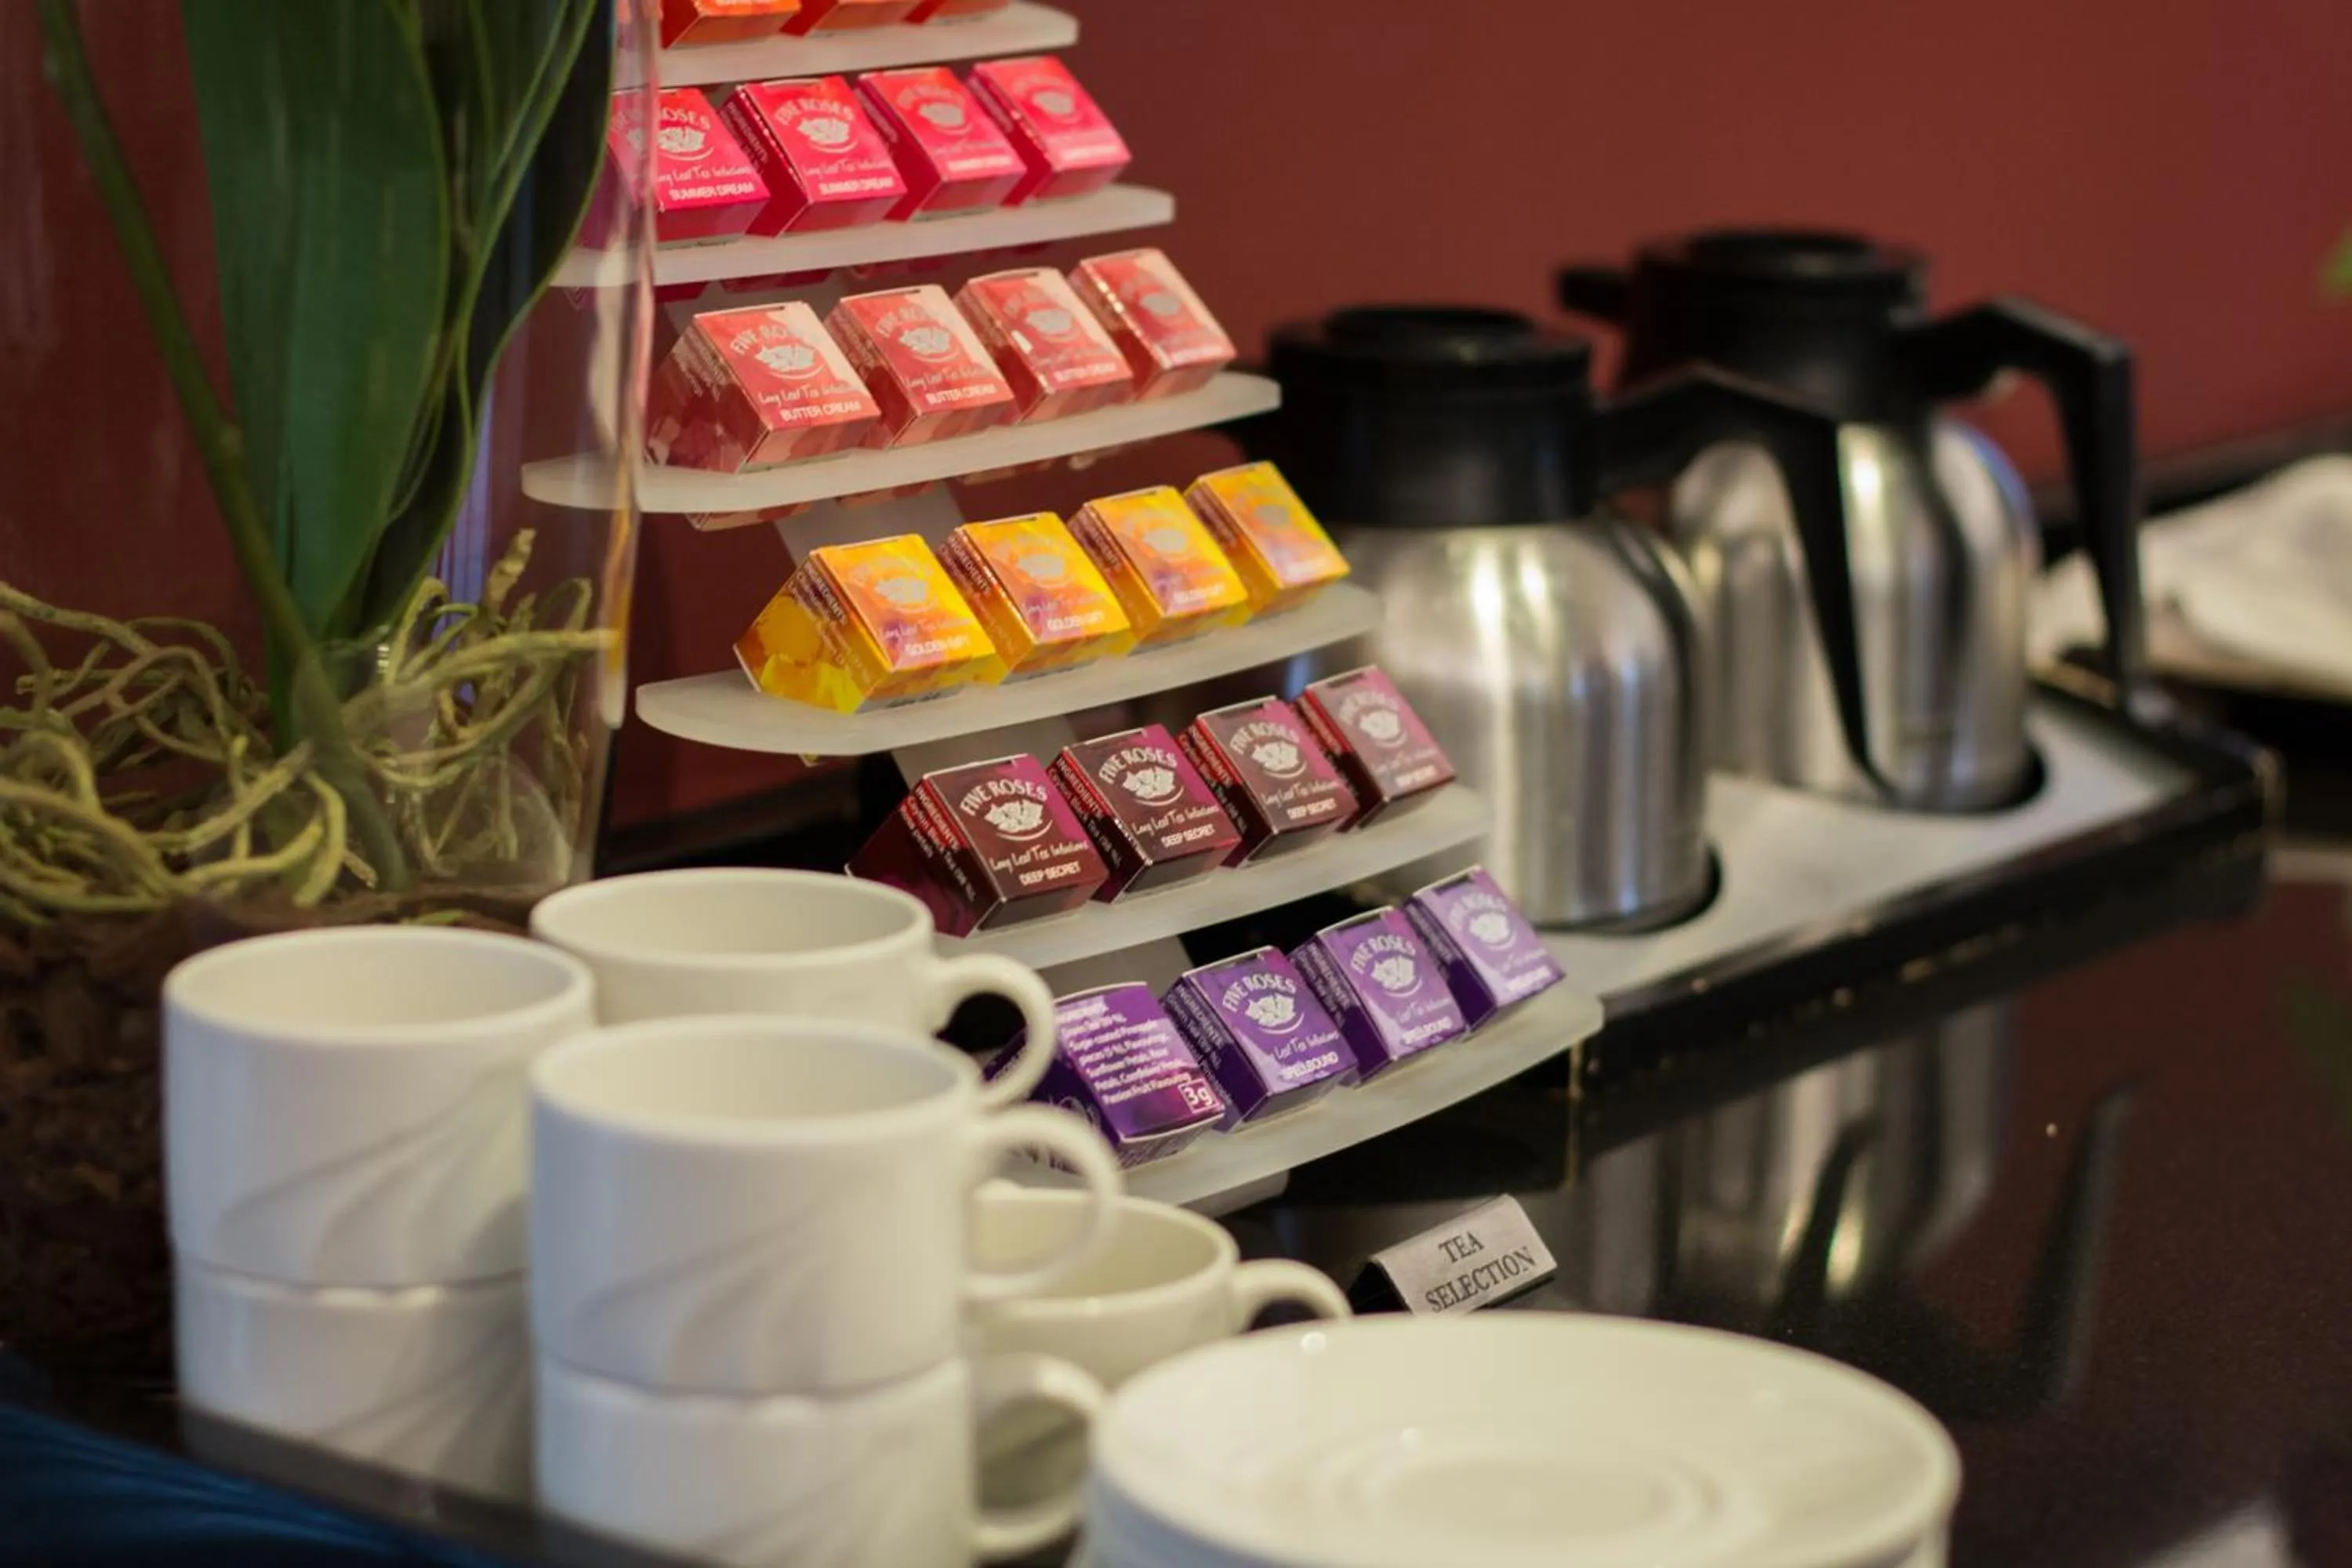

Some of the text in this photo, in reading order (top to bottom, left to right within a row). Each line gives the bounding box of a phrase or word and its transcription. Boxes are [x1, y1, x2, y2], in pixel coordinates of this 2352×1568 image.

[780, 400, 862, 422] BUTTER CREAM
[1229, 726, 1254, 755] FIVE
[1248, 722, 1301, 744] ROSES
[1098, 746, 1178, 784] FIVE ROSES
[959, 779, 1049, 817] FIVE ROSES
[1287, 797, 1338, 821] DEEP SECRET
[1131, 822, 1155, 837] Long
[1150, 813, 1171, 830] Leaf
[1167, 808, 1185, 824] Tea
[1160, 823, 1215, 848] DEEP SECRET
[989, 857, 1014, 874] Long
[1011, 849, 1032, 867] Leaf
[1029, 844, 1051, 861] Tea
[1018, 861, 1082, 886] DEEP SECRET
[1222, 972, 1297, 1013] FIVE ROSES
[1279, 1051, 1340, 1080] SPELLBOUND
[1182, 1085, 1214, 1106] 3g
[1438, 1230, 1485, 1265] TEA
[1425, 1245, 1539, 1314] SELECTION
